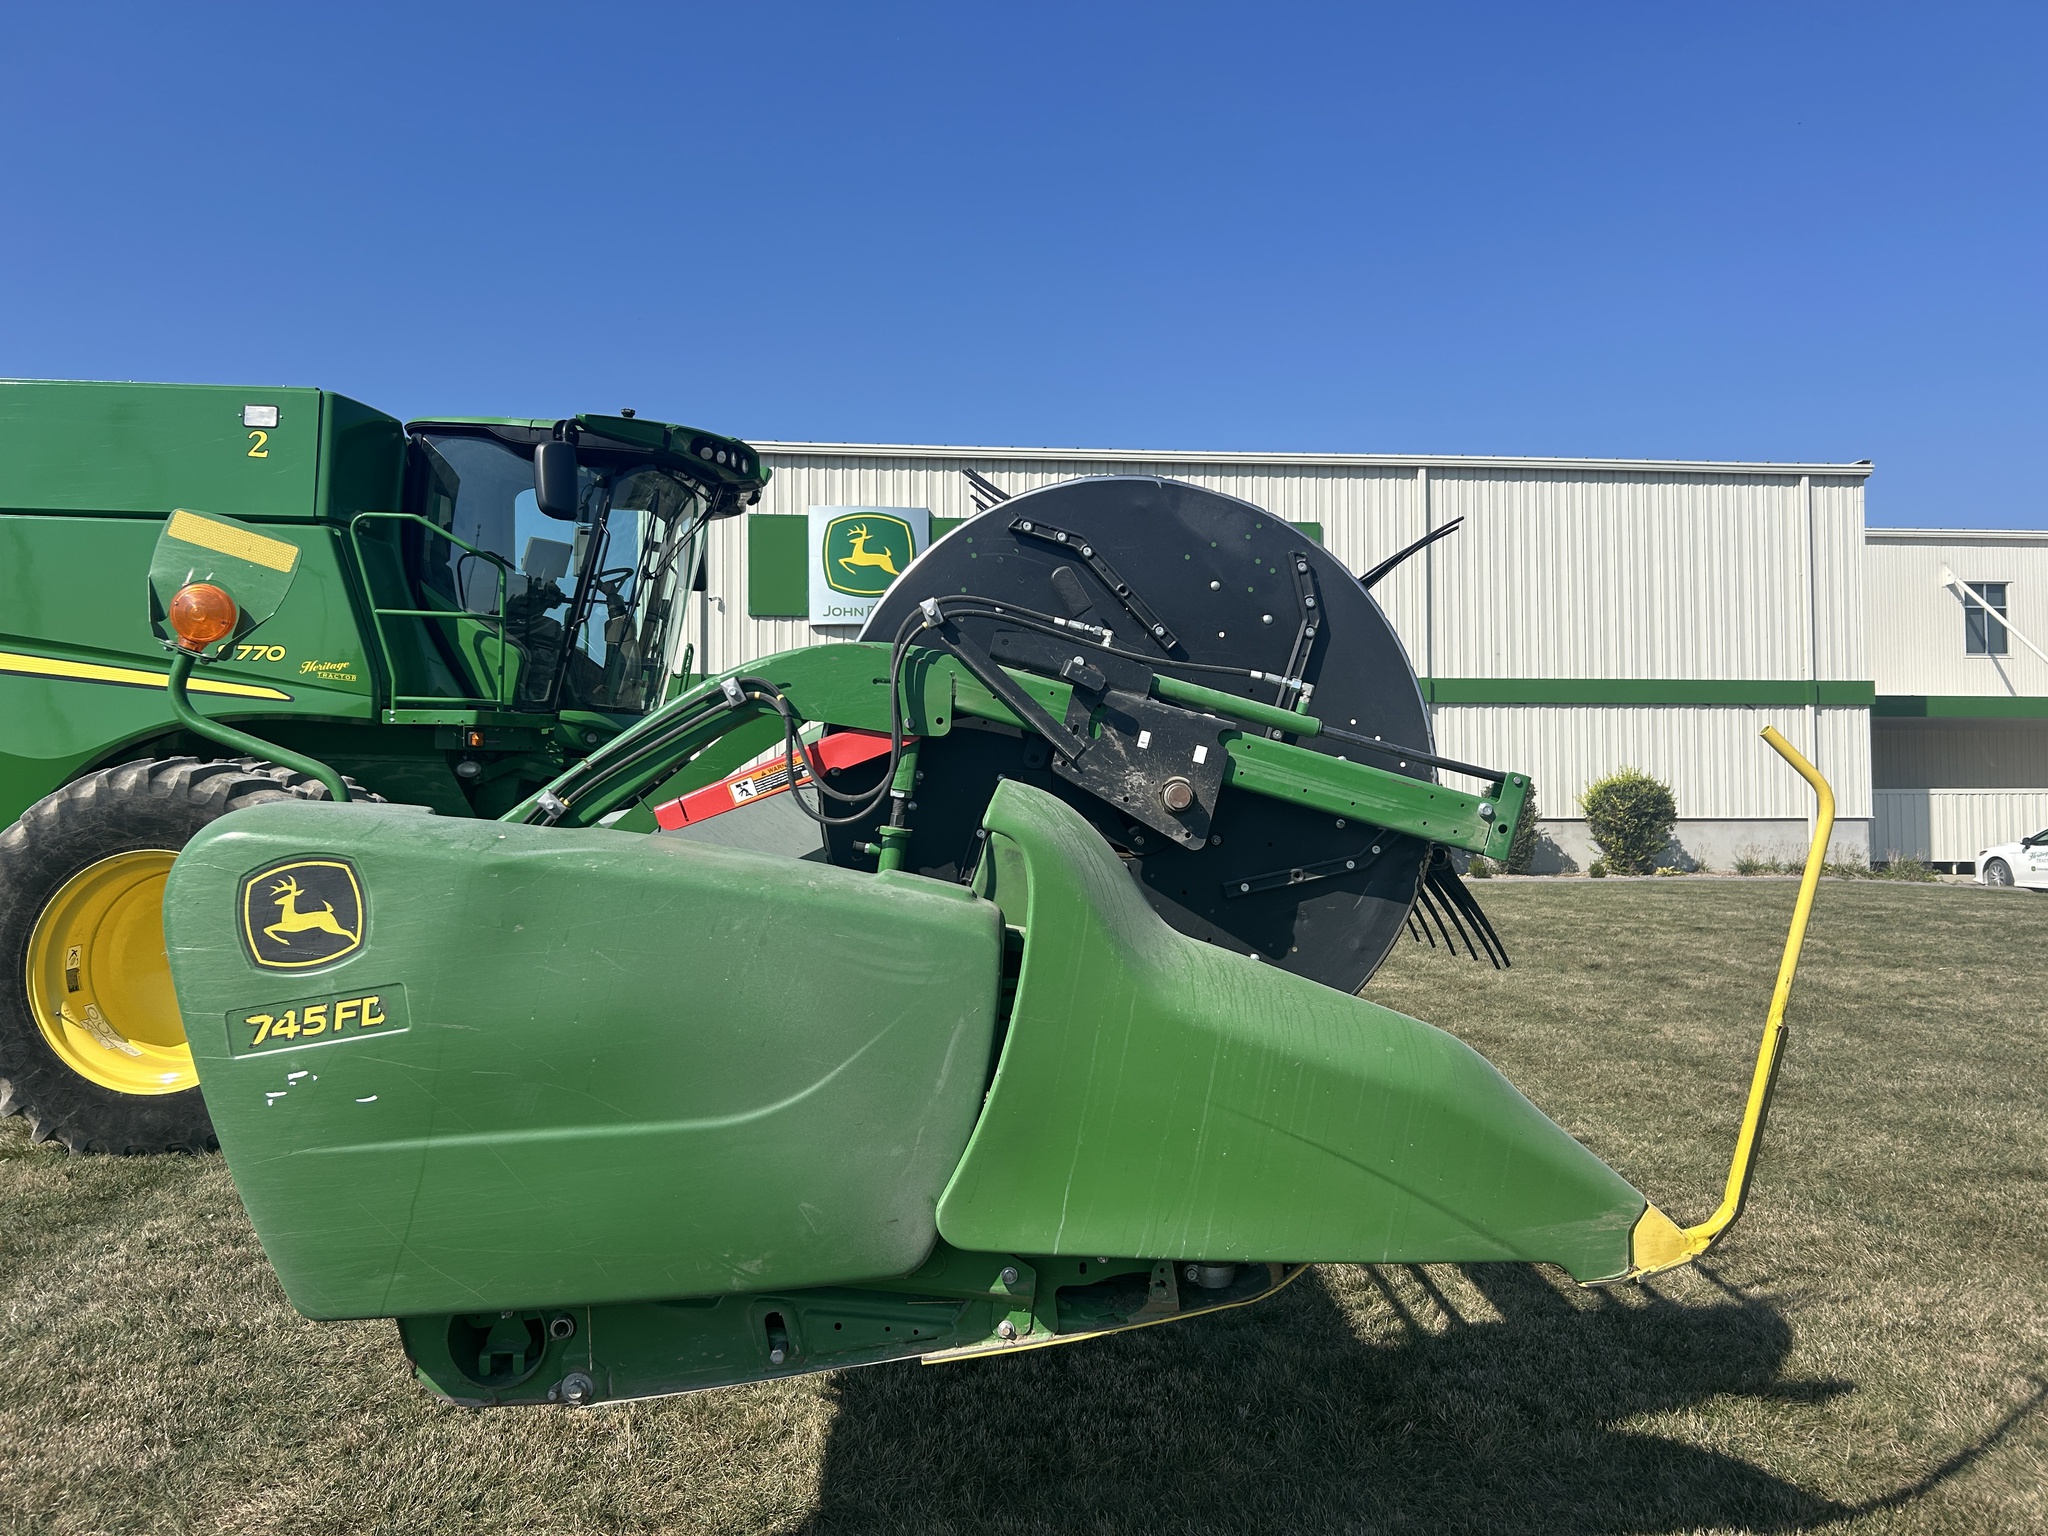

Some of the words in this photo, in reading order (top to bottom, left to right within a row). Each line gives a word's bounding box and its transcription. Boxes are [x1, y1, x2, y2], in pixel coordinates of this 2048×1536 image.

[247, 430, 270, 459] 2
[822, 604, 865, 618] JOHN
[217, 643, 287, 662] 770
[299, 659, 350, 674] Heritage
[317, 671, 357, 682] TRACTOR
